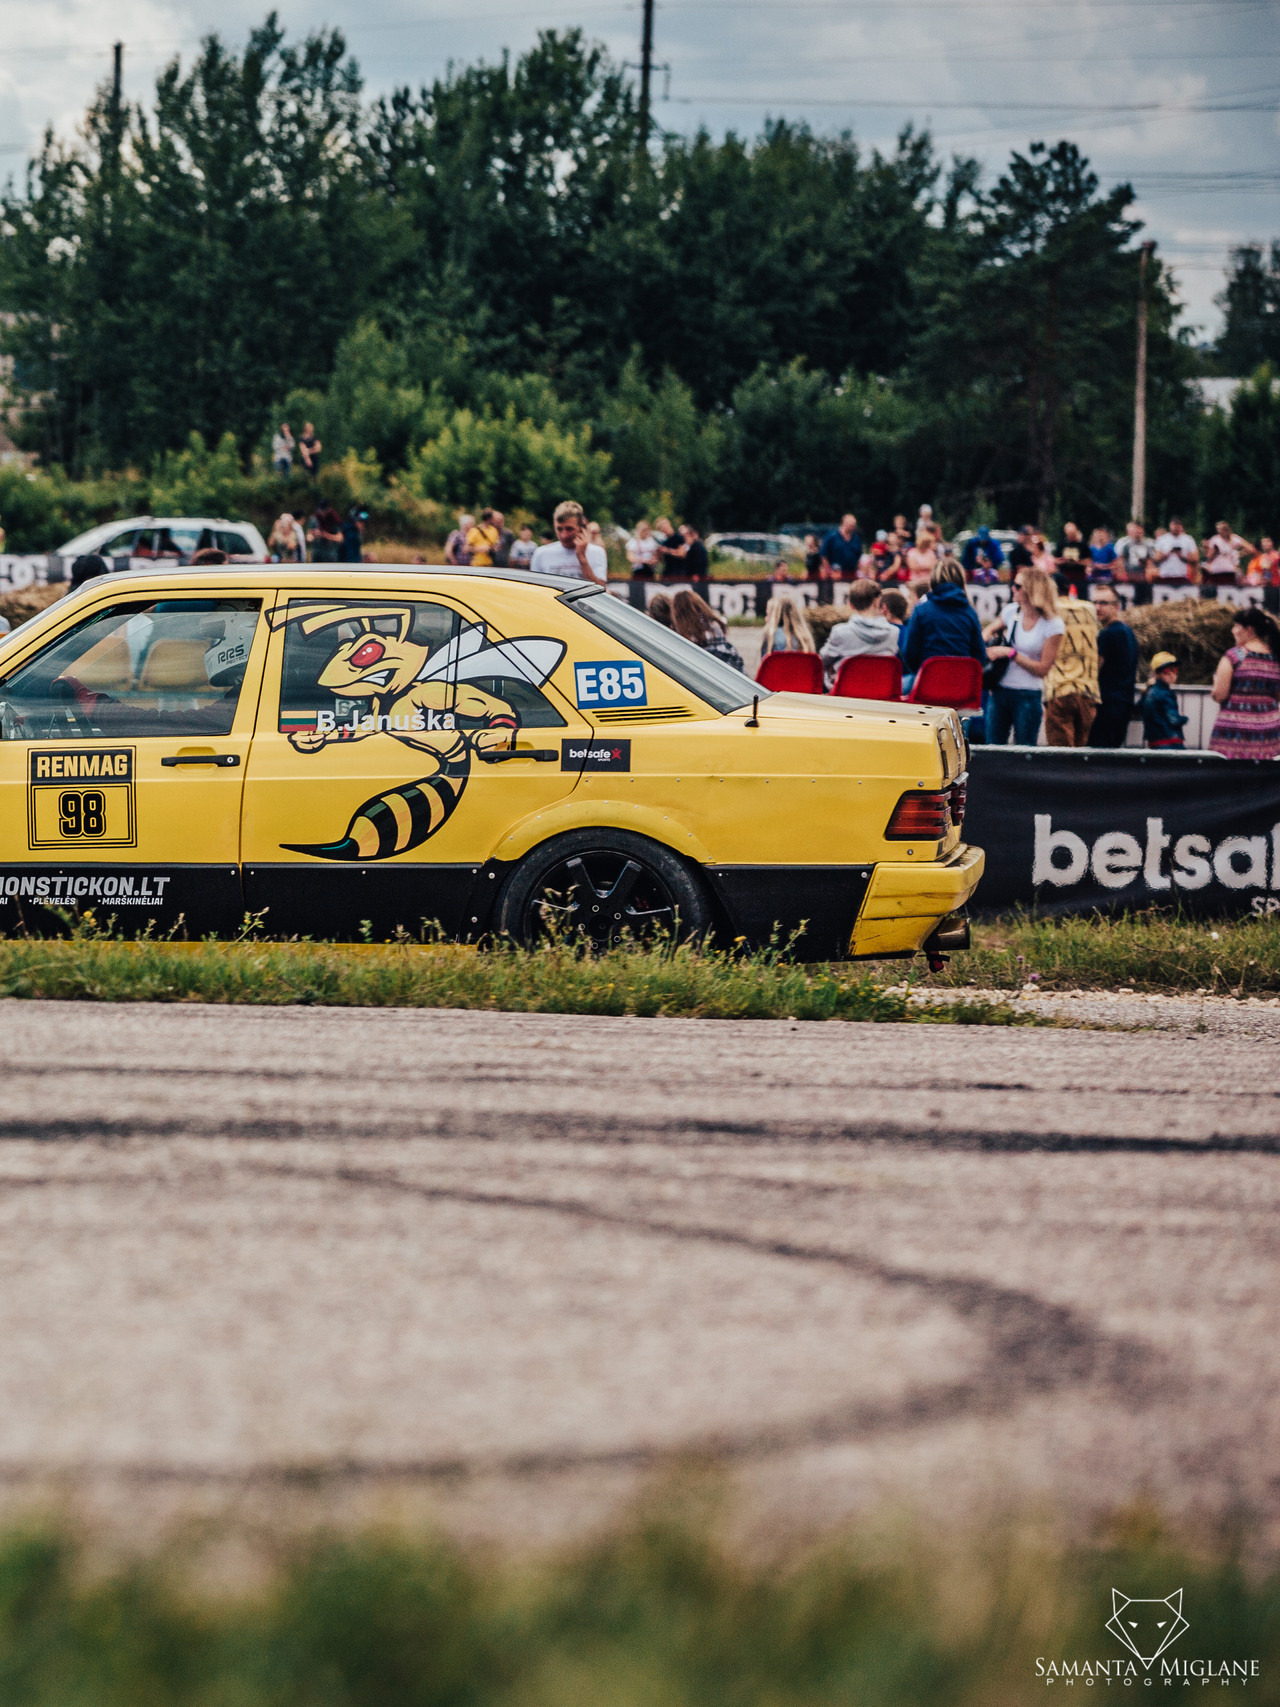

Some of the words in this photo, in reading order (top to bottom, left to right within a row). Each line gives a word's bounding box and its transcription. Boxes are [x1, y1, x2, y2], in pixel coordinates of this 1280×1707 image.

[218, 644, 245, 664] RRS
[577, 667, 644, 702] E85
[317, 708, 456, 732] B.Januška
[37, 754, 128, 778] RENMAG
[569, 749, 611, 759] betsafe
[59, 790, 107, 838] 98
[1032, 813, 1280, 891] betsa
